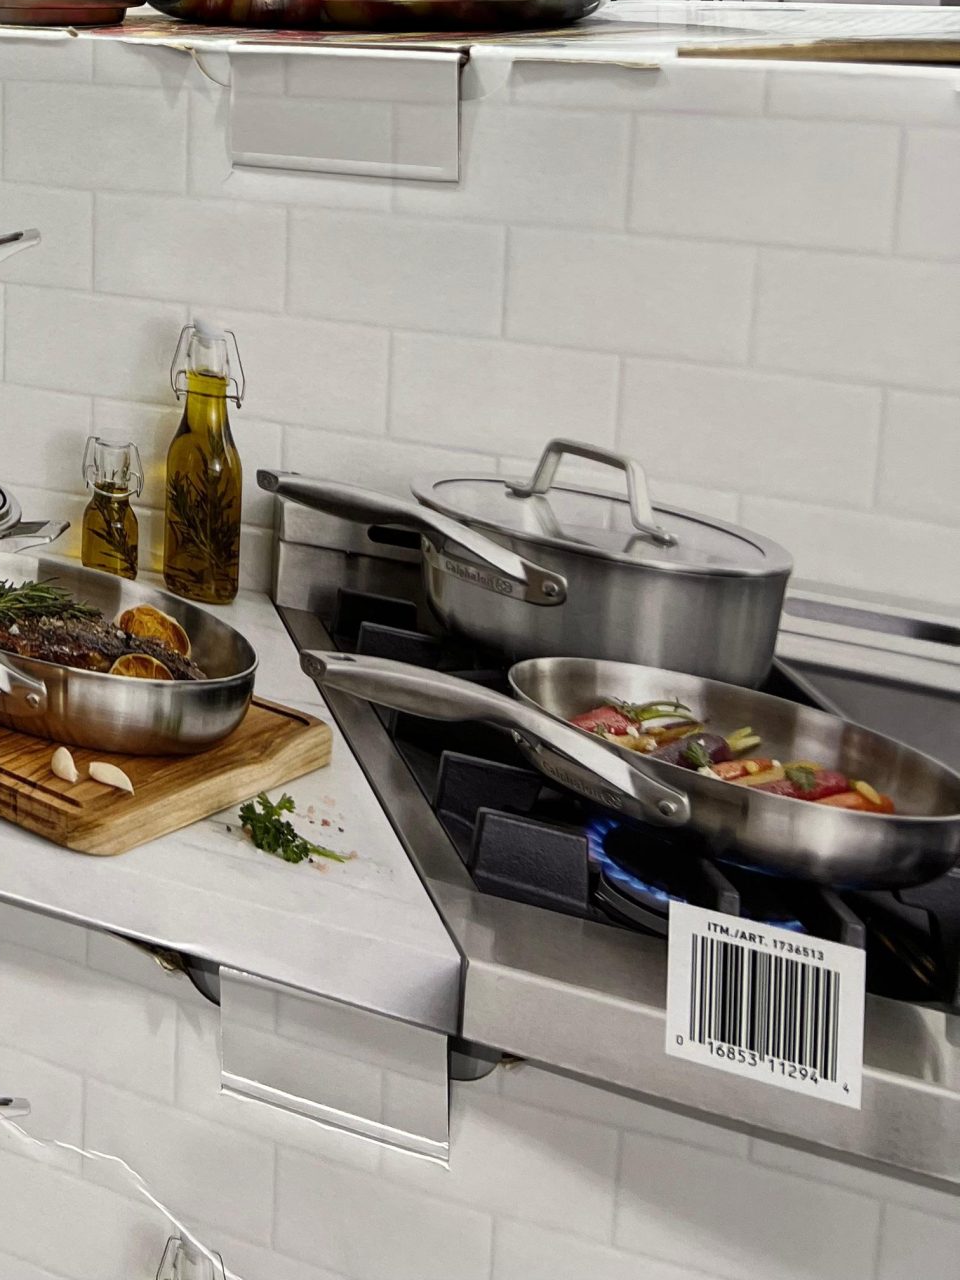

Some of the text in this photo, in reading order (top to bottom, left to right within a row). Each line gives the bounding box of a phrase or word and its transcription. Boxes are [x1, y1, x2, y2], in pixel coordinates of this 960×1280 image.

[773, 939, 824, 961] 1736513
[676, 1035, 850, 1094] 0 16853 11294 4
